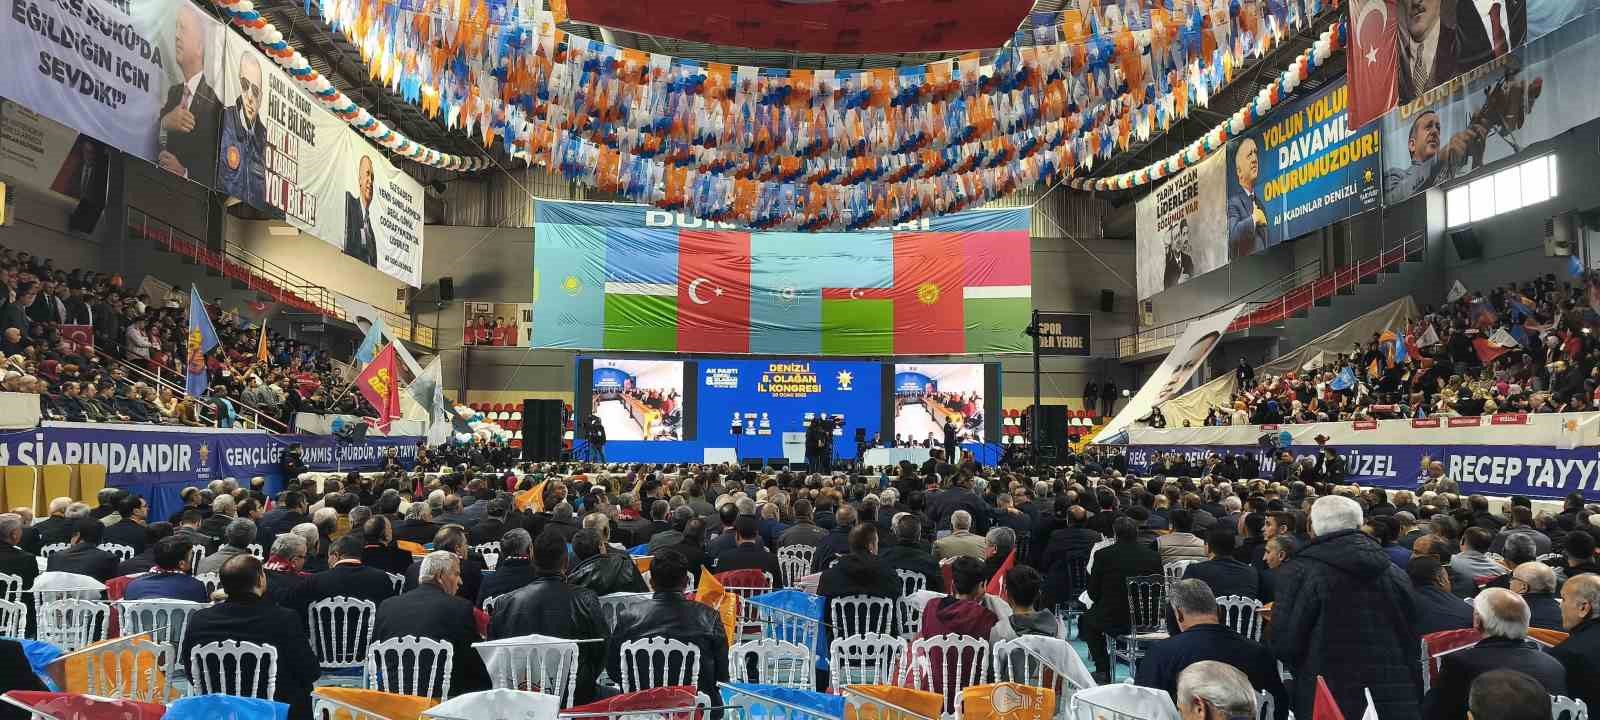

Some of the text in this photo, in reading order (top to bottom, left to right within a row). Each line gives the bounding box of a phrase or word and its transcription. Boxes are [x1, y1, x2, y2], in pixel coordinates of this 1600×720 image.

[115, 56, 150, 93] İÇİN
[268, 92, 286, 126] HİLE
[1263, 110, 1303, 152] YOLUN
[1263, 130, 1380, 202] ONURUMUZDUR!
[1156, 181, 1199, 219] LİDERLERE
[1324, 181, 1358, 206] DENİZLİ
[769, 362, 810, 373] DENİZLİ
[773, 372, 817, 384] OLAĞAN
[1449, 454, 1522, 485] RECEP
